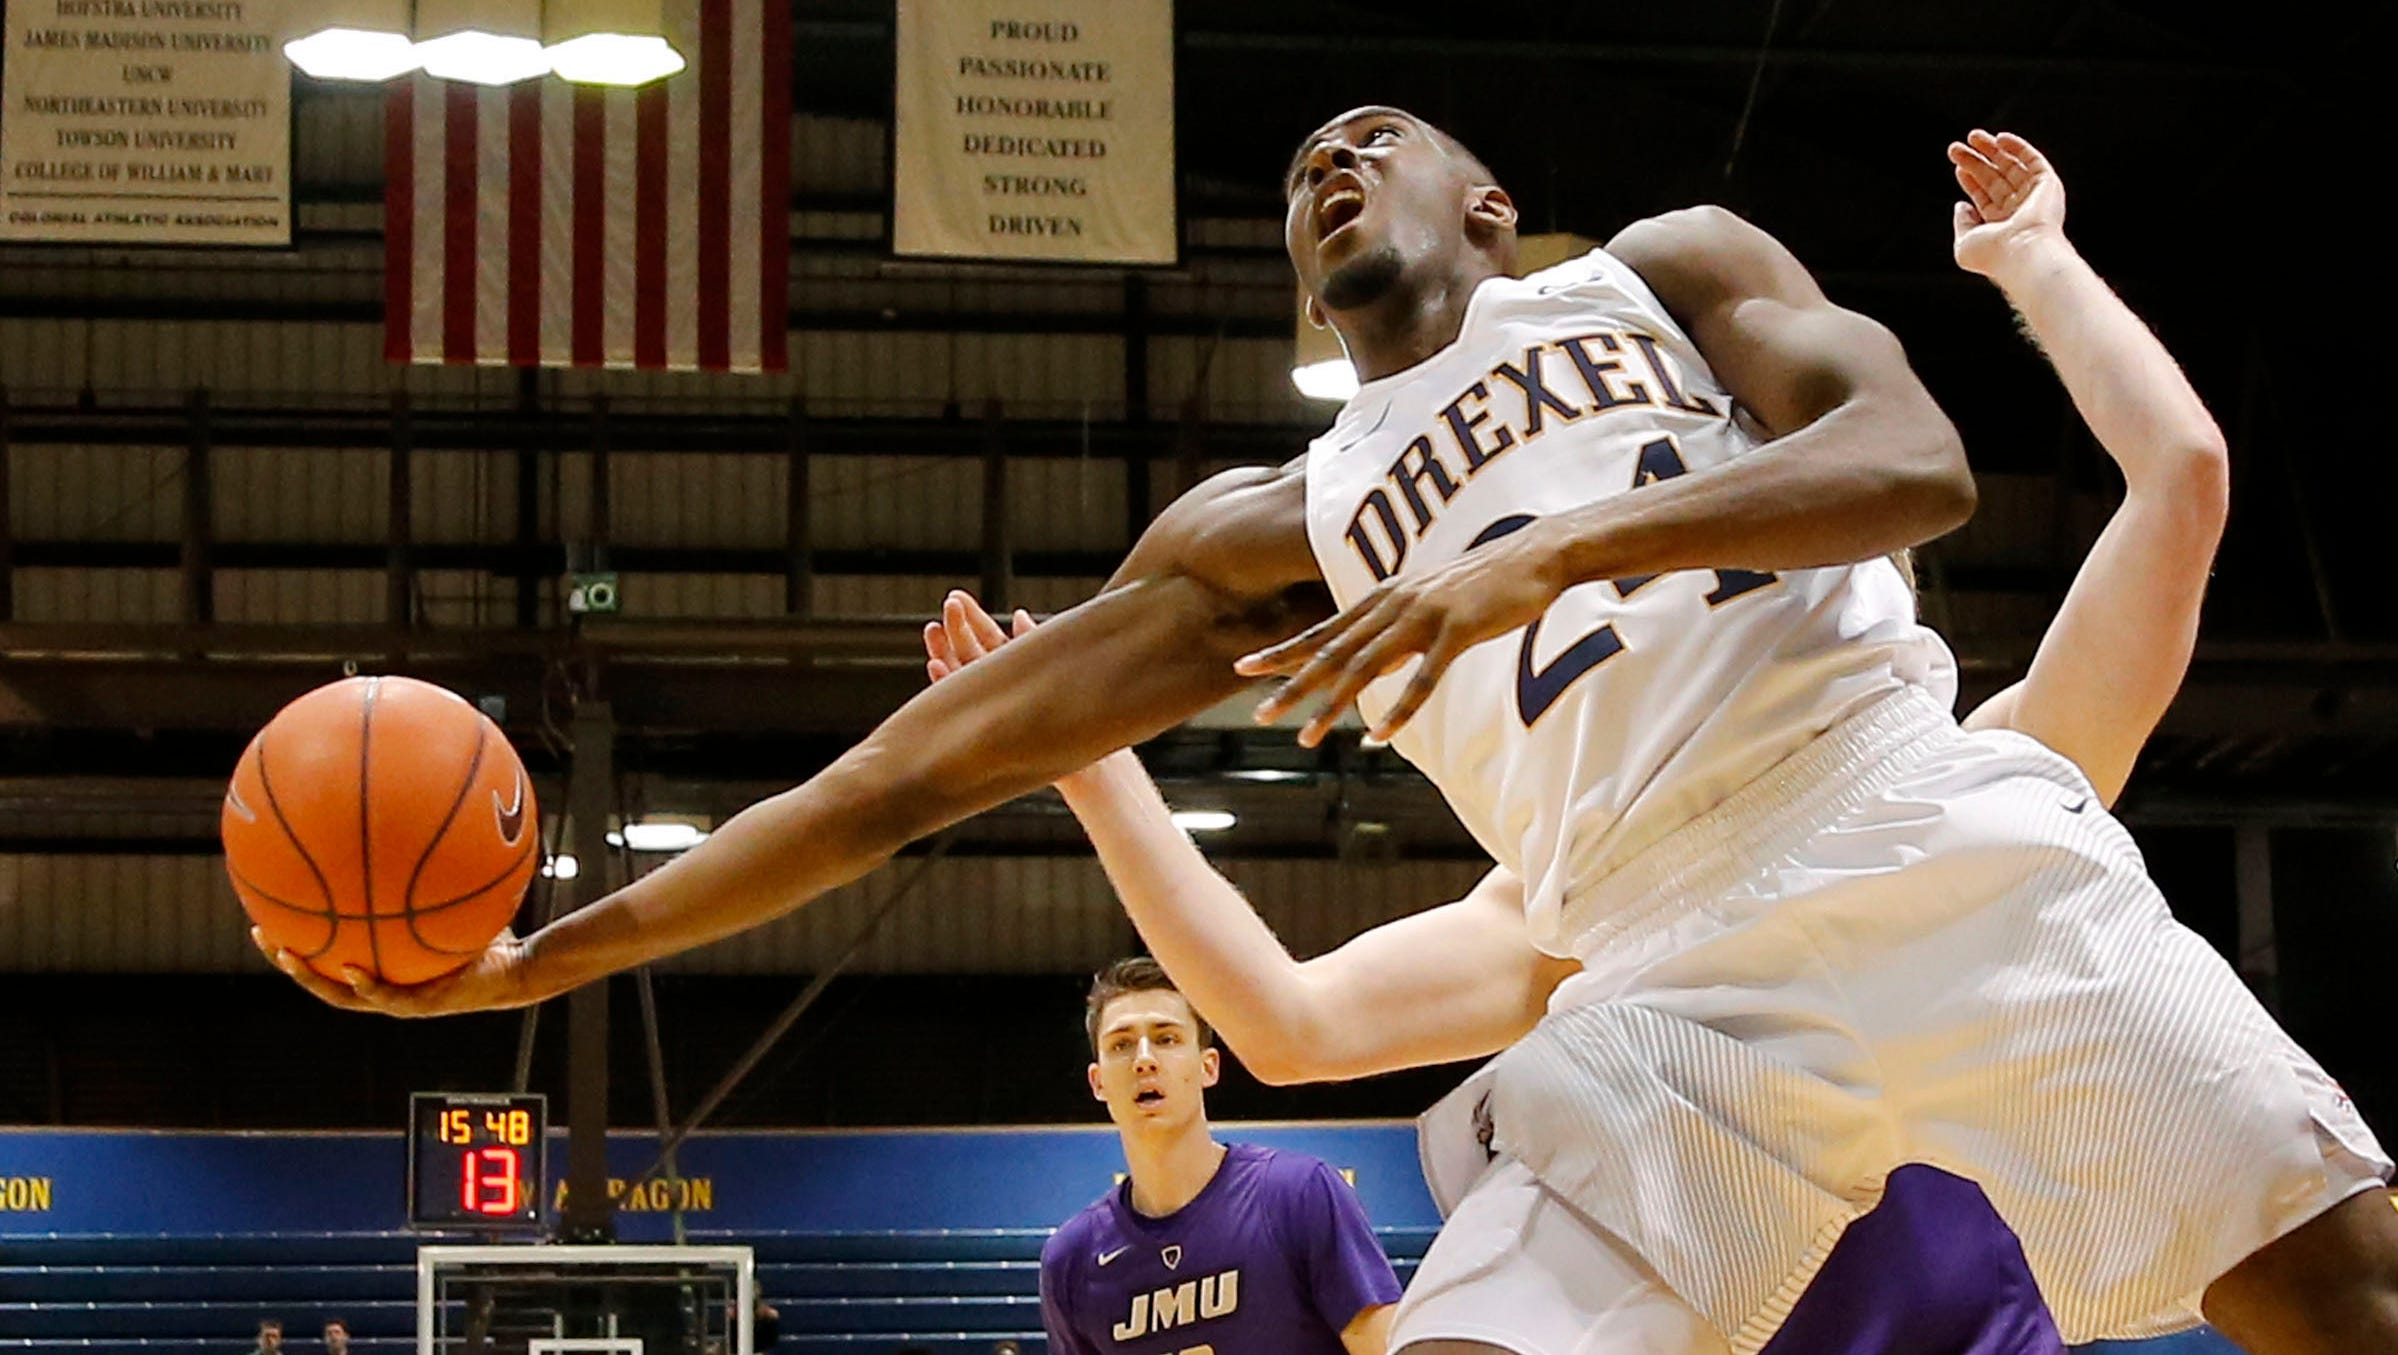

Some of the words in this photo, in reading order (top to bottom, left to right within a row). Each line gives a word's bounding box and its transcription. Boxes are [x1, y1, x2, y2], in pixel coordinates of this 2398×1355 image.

[142, 1, 242, 20] UNIVERSITY
[24, 29, 81, 48] JAMES
[85, 30, 165, 50] MADISON
[171, 31, 271, 53] UNIVERSITY
[990, 20, 1079, 42] PROUD
[121, 64, 174, 83] UNCW
[959, 56, 1111, 82] PASSIONATE
[24, 96, 162, 117] NORTHEASTERN
[168, 97, 268, 118] UNIVERSITY
[956, 95, 1113, 120] HONORABLE
[57, 129, 129, 148] TOWSON
[134, 130, 237, 150] UNIVERSITY
[963, 133, 1107, 158] DEDICATED
[15, 160, 92, 180] COLLEGE
[99, 162, 120, 182] OF
[127, 162, 202, 182] WILLIAM
[983, 173, 1087, 196] STRONG
[9, 211, 86, 224] COLONIAL
[94, 212, 169, 225] ATHLETIC
[175, 213, 279, 227] ASSOCIATION
[989, 214, 1082, 237] DRIVEN
[1344, 332, 1730, 584] DREXEL
[440, 1109, 471, 1145] 15
[485, 1109, 530, 1146] 48
[462, 1147, 520, 1215] 13
[1112, 1269, 1239, 1341] JMU
